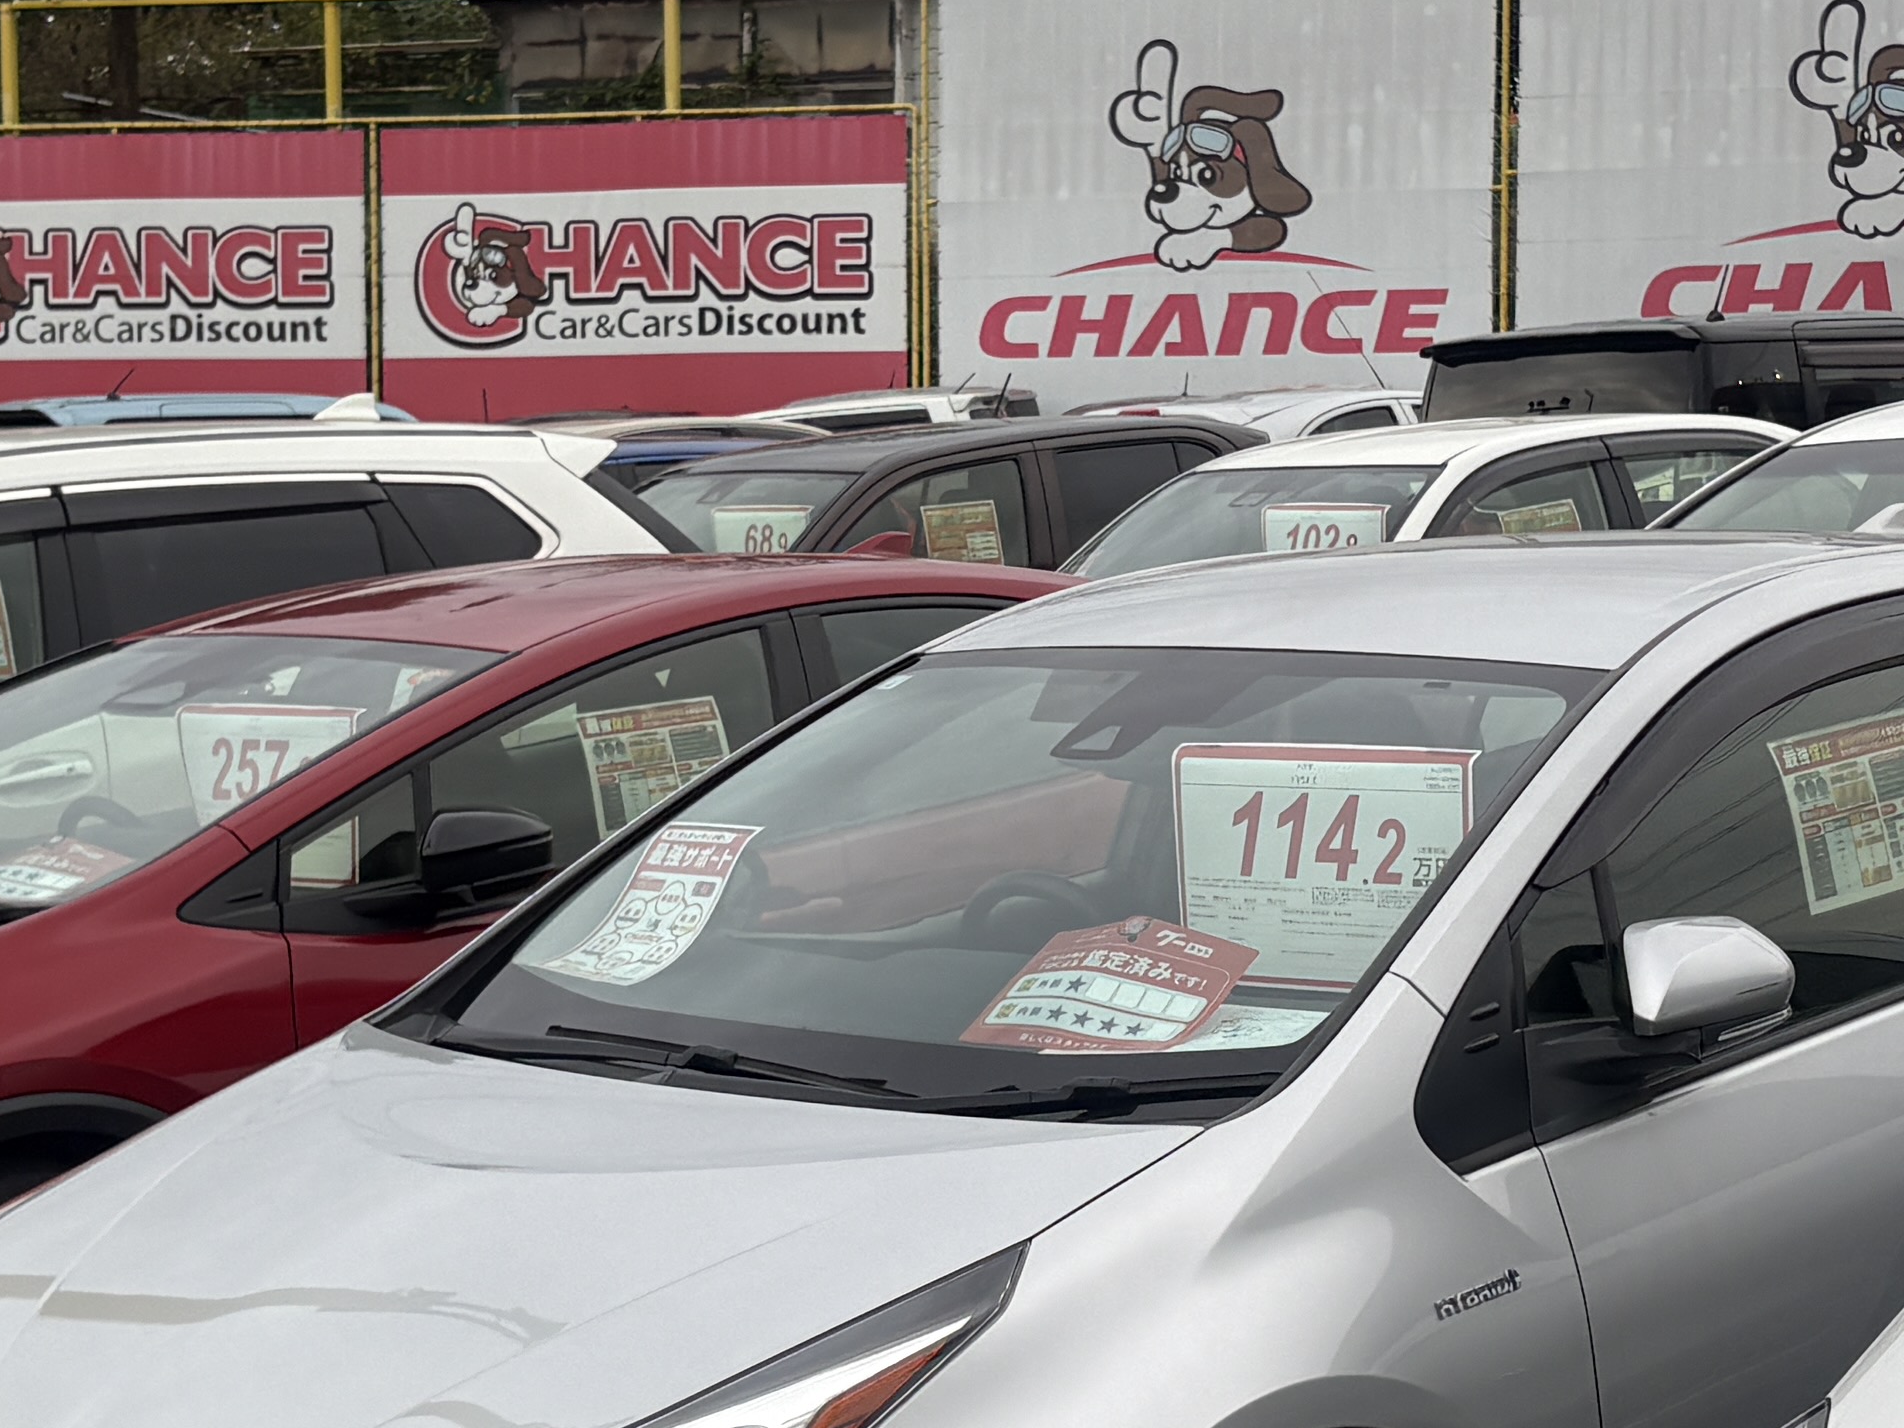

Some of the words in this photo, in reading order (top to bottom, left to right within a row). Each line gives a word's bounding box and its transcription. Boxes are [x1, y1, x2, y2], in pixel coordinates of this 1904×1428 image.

[414, 213, 873, 349] CHANCE
[979, 289, 1449, 358] CHANCE
[1232, 791, 1406, 885] 114.2
